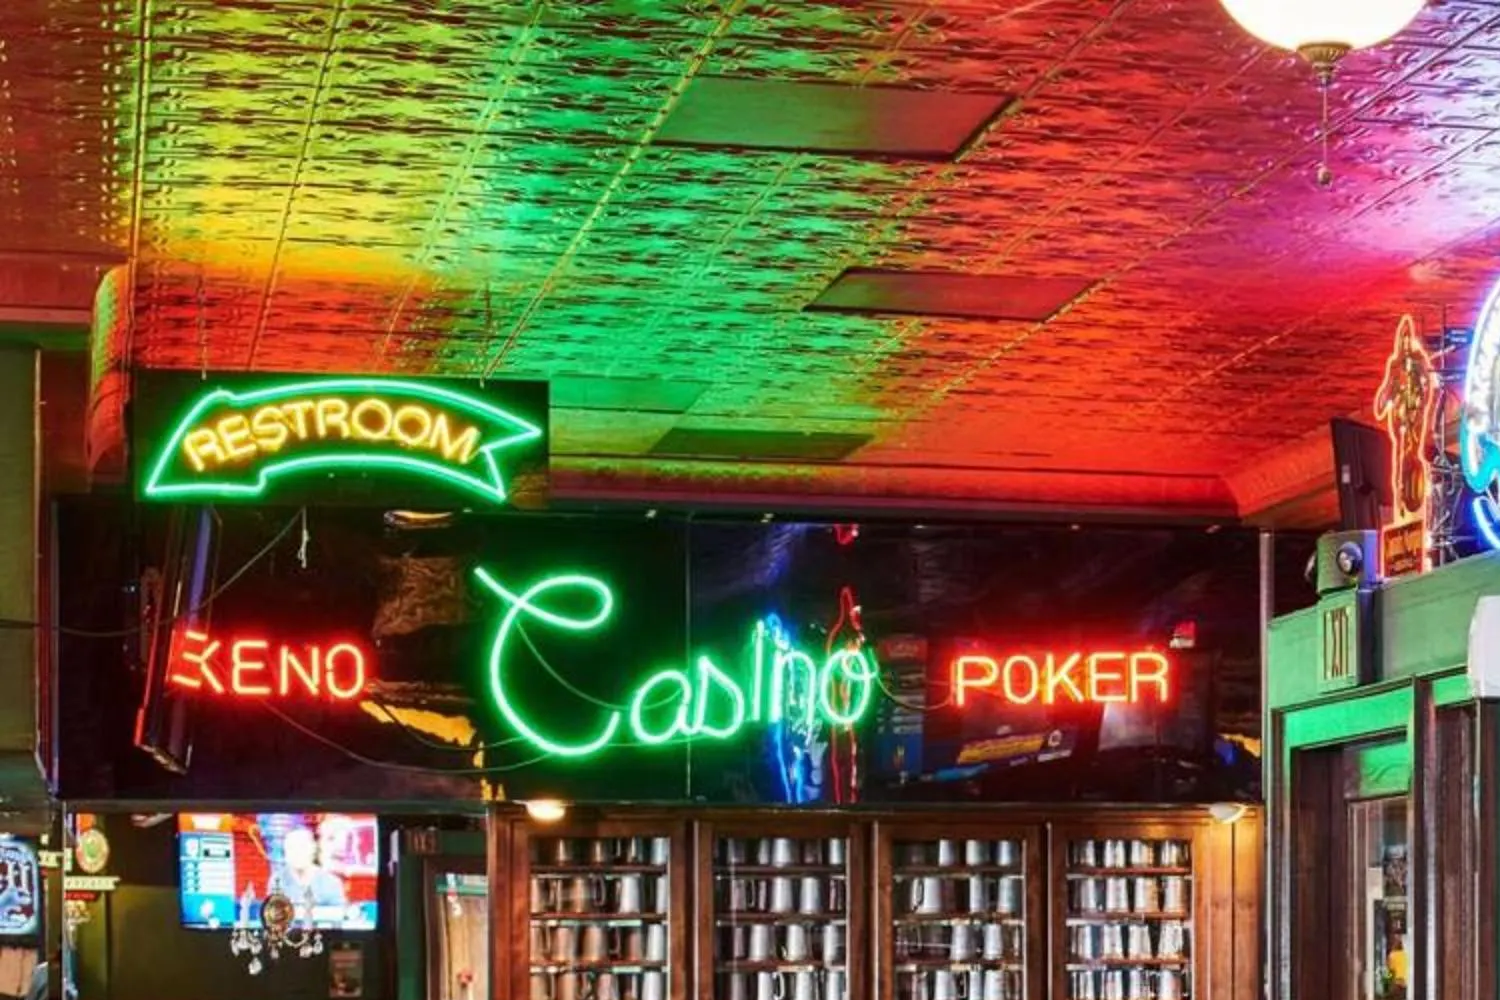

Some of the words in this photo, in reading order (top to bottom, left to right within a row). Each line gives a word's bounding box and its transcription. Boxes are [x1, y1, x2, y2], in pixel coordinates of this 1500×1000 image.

[182, 397, 482, 473] RESTROOM
[172, 630, 365, 699] KENO
[471, 564, 878, 758] Casino
[953, 650, 1170, 707] POKER
